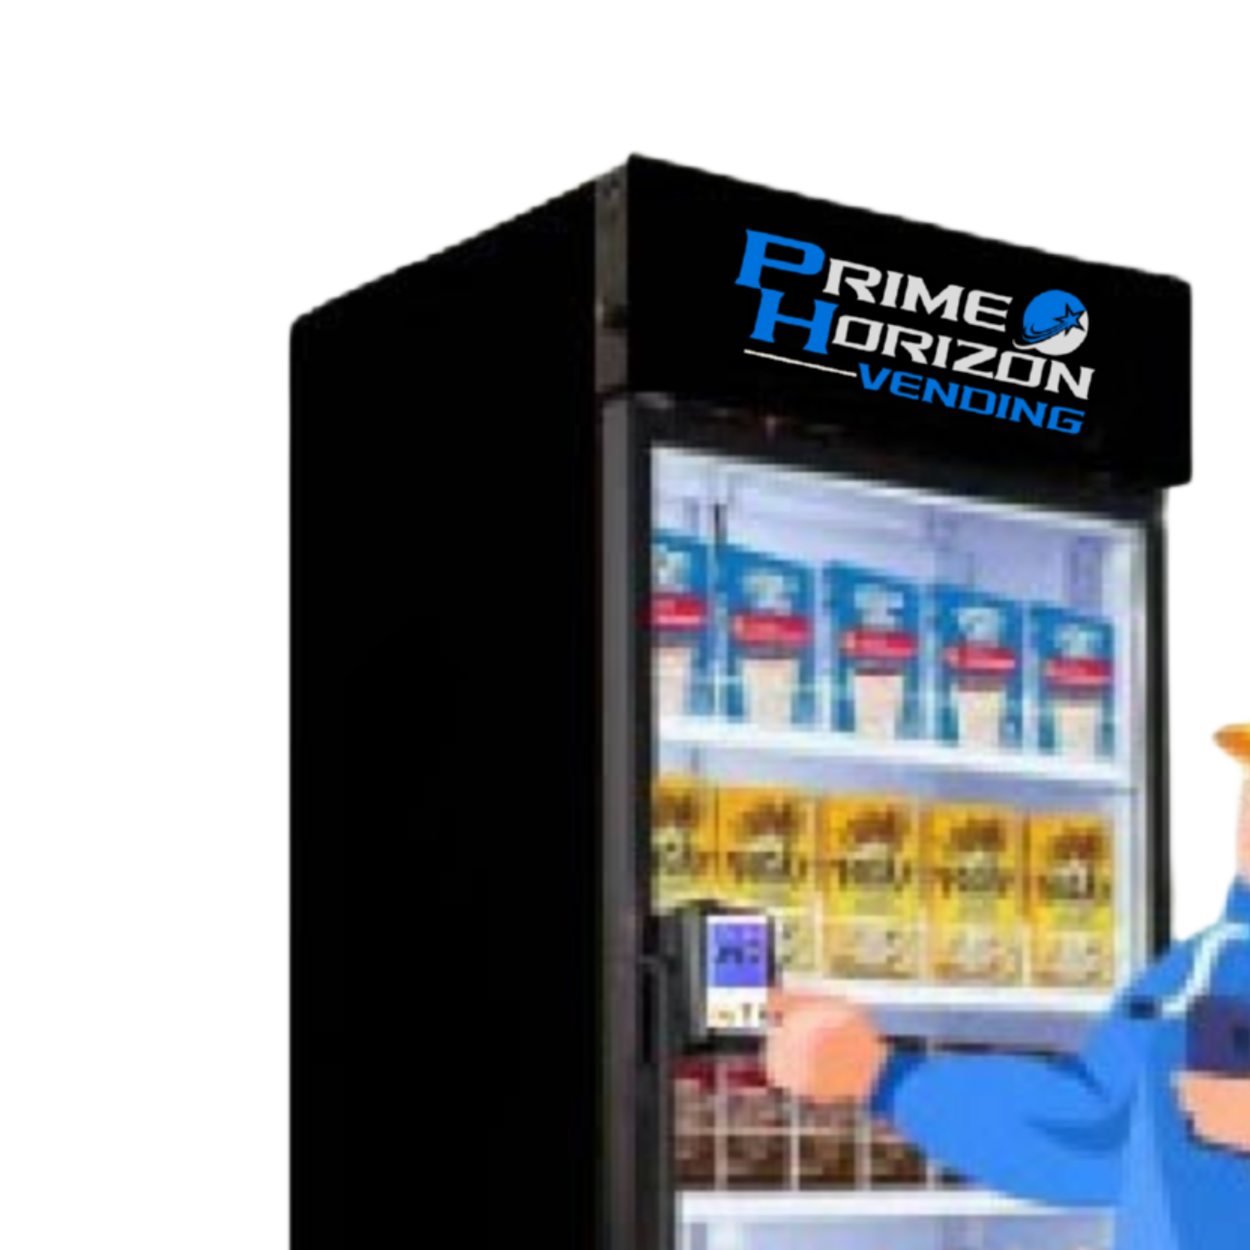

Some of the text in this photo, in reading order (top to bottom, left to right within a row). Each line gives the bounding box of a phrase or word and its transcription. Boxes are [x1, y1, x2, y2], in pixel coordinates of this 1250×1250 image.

[735, 229, 1013, 332] PRIME
[748, 286, 1095, 400] HORIZON
[858, 362, 1086, 435] VENDING
